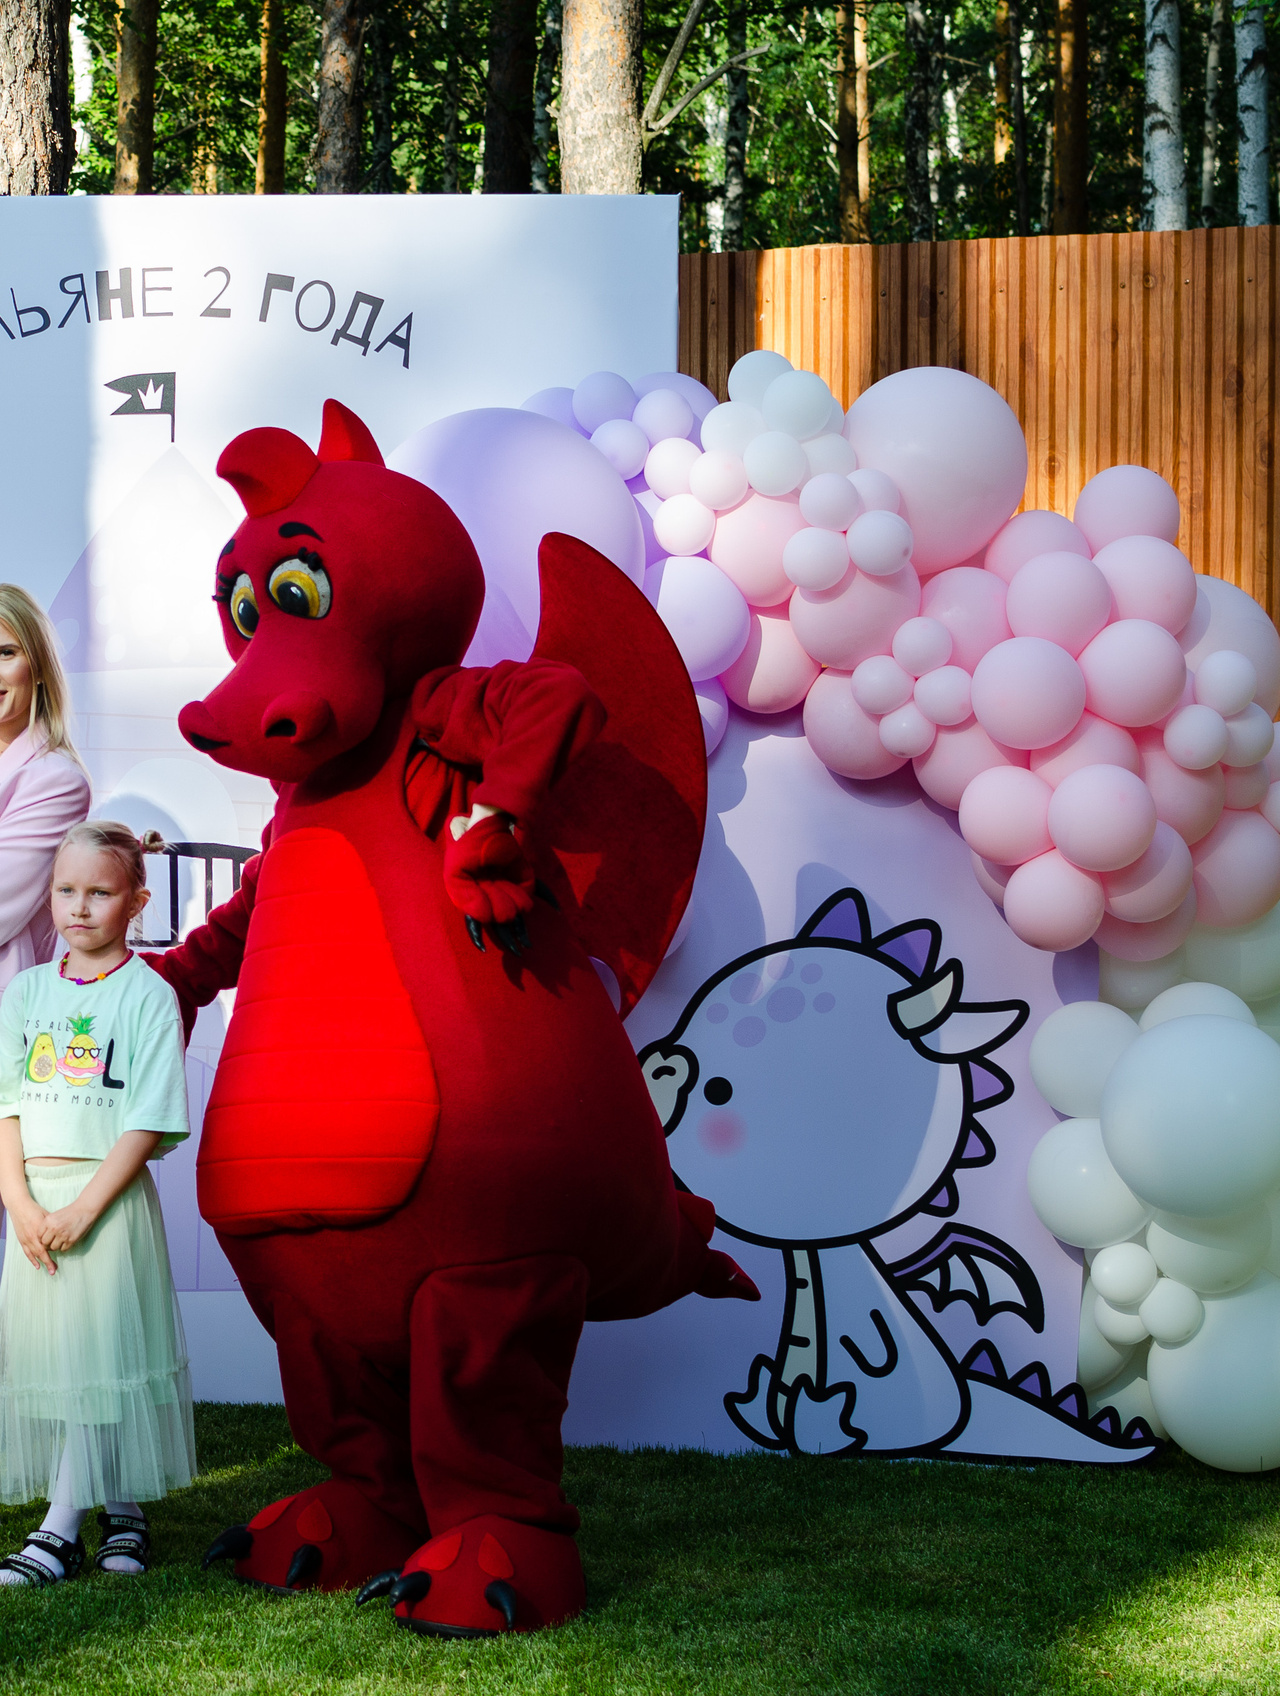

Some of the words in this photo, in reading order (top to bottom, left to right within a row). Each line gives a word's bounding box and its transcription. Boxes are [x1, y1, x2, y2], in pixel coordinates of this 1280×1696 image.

[200, 266, 231, 319] 2
[258, 272, 414, 369] ГОДА
[71, 1095, 114, 1108] MOOD
